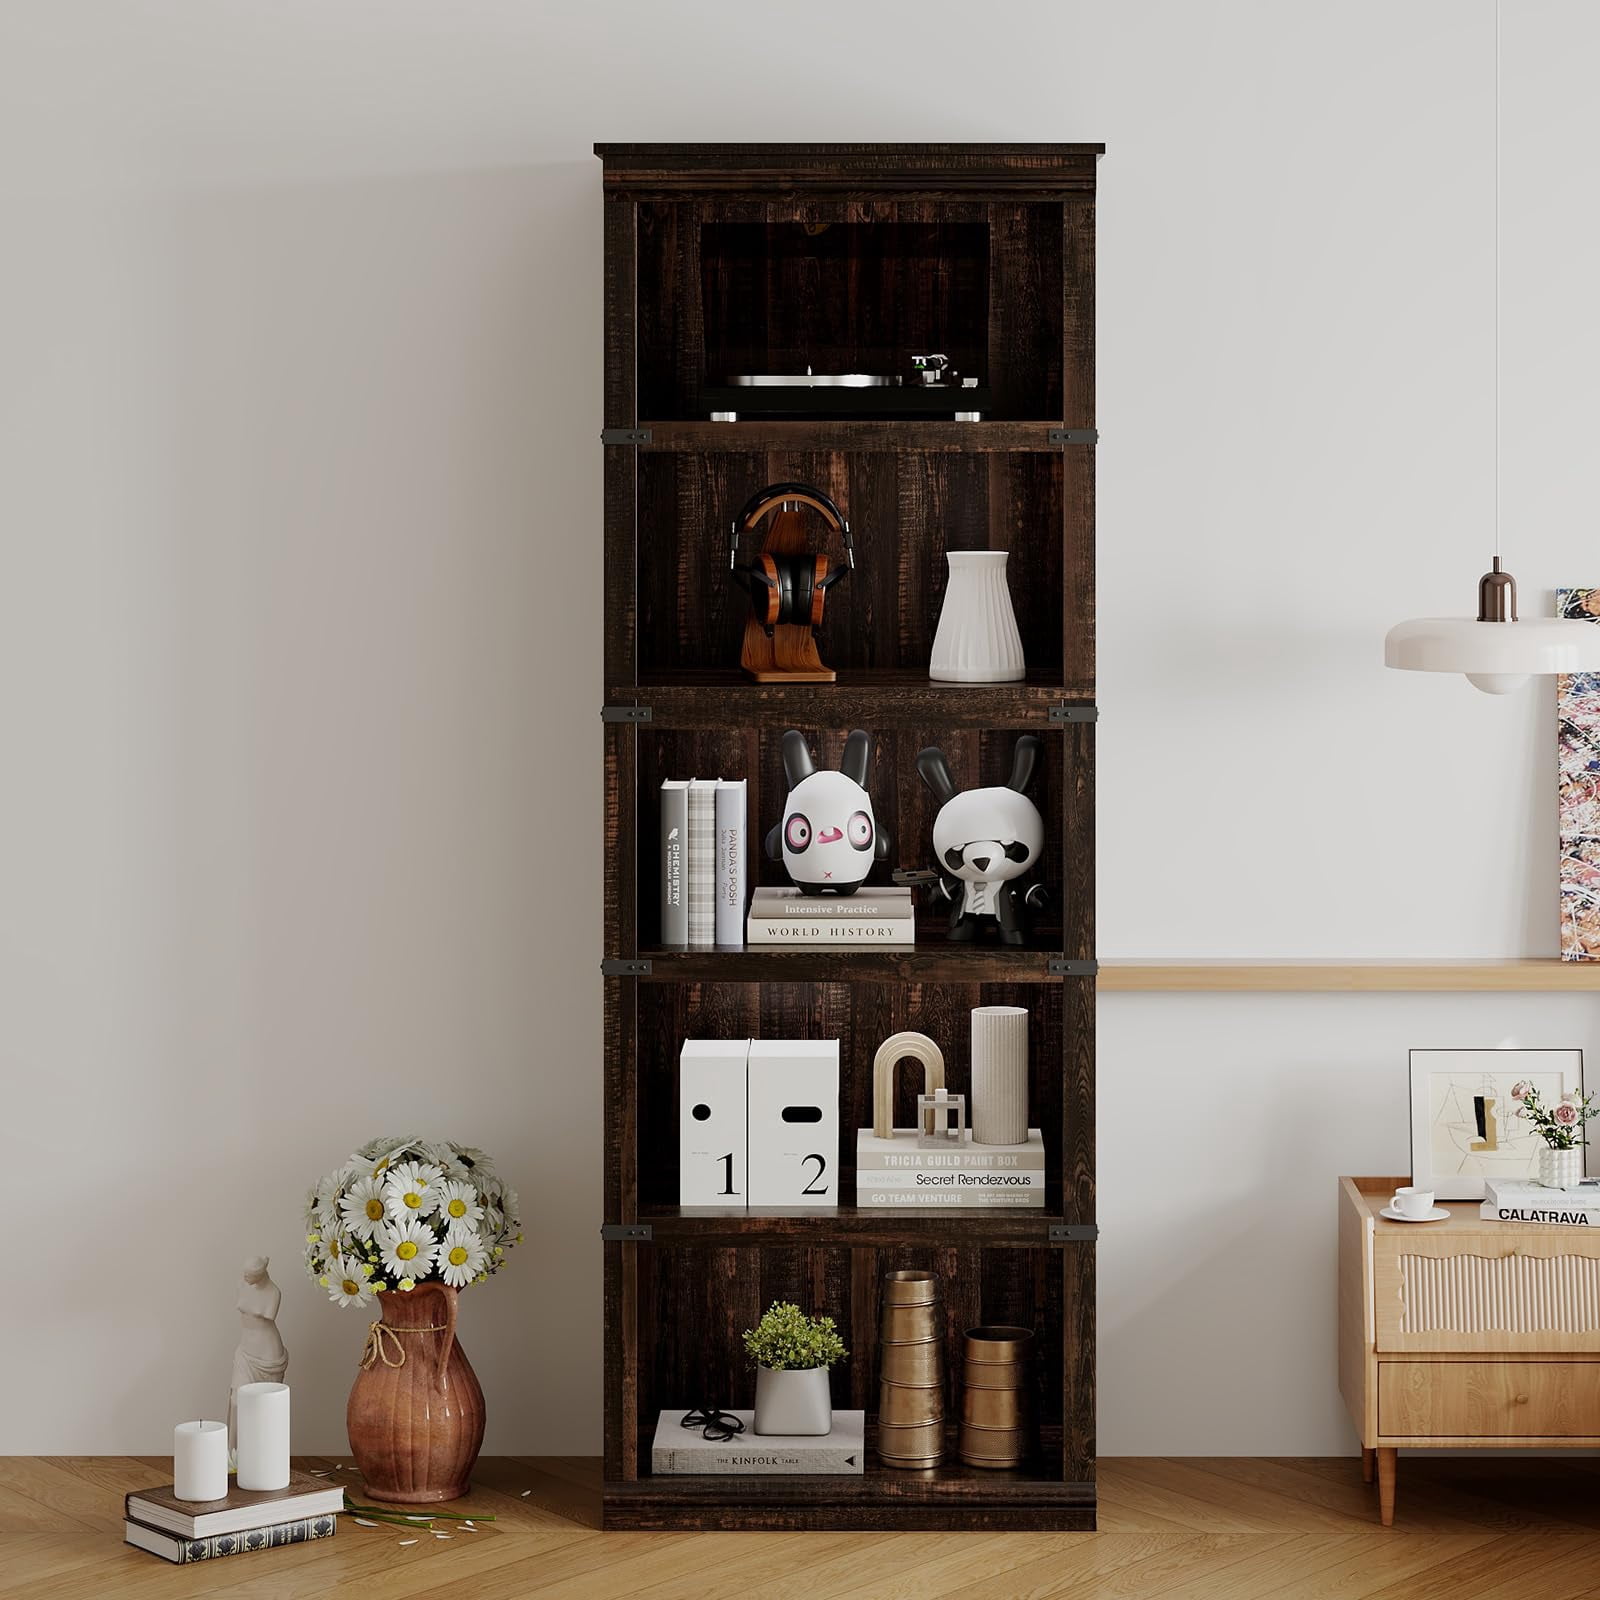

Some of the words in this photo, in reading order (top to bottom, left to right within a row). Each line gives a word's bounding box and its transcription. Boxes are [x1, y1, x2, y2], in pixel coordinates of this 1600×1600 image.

[729, 829, 738, 874] PANDA'S
[672, 843, 680, 906] CHEMISTRY
[729, 877, 738, 906] POSH
[785, 904, 832, 914] Intensive
[837, 904, 878, 914] Practice
[767, 927, 820, 937] WORLD
[830, 927, 895, 937] HISTORY
[884, 1155, 922, 1167] TRICIA
[927, 1155, 961, 1167] GUILD
[964, 1155, 994, 1167] PAINT
[997, 1155, 1018, 1167] BOX
[716, 1152, 741, 1195] 1
[801, 1153, 829, 1195] 2
[916, 1173, 954, 1186] Secret
[958, 1173, 1031, 1186] Rendezvous
[871, 1193, 886, 1203] GO
[888, 1193, 916, 1203] TEAM
[918, 1193, 962, 1203] VENTURE
[1498, 1208, 1589, 1225] CALATRAVA
[731, 1456, 778, 1465] KINFOLK
